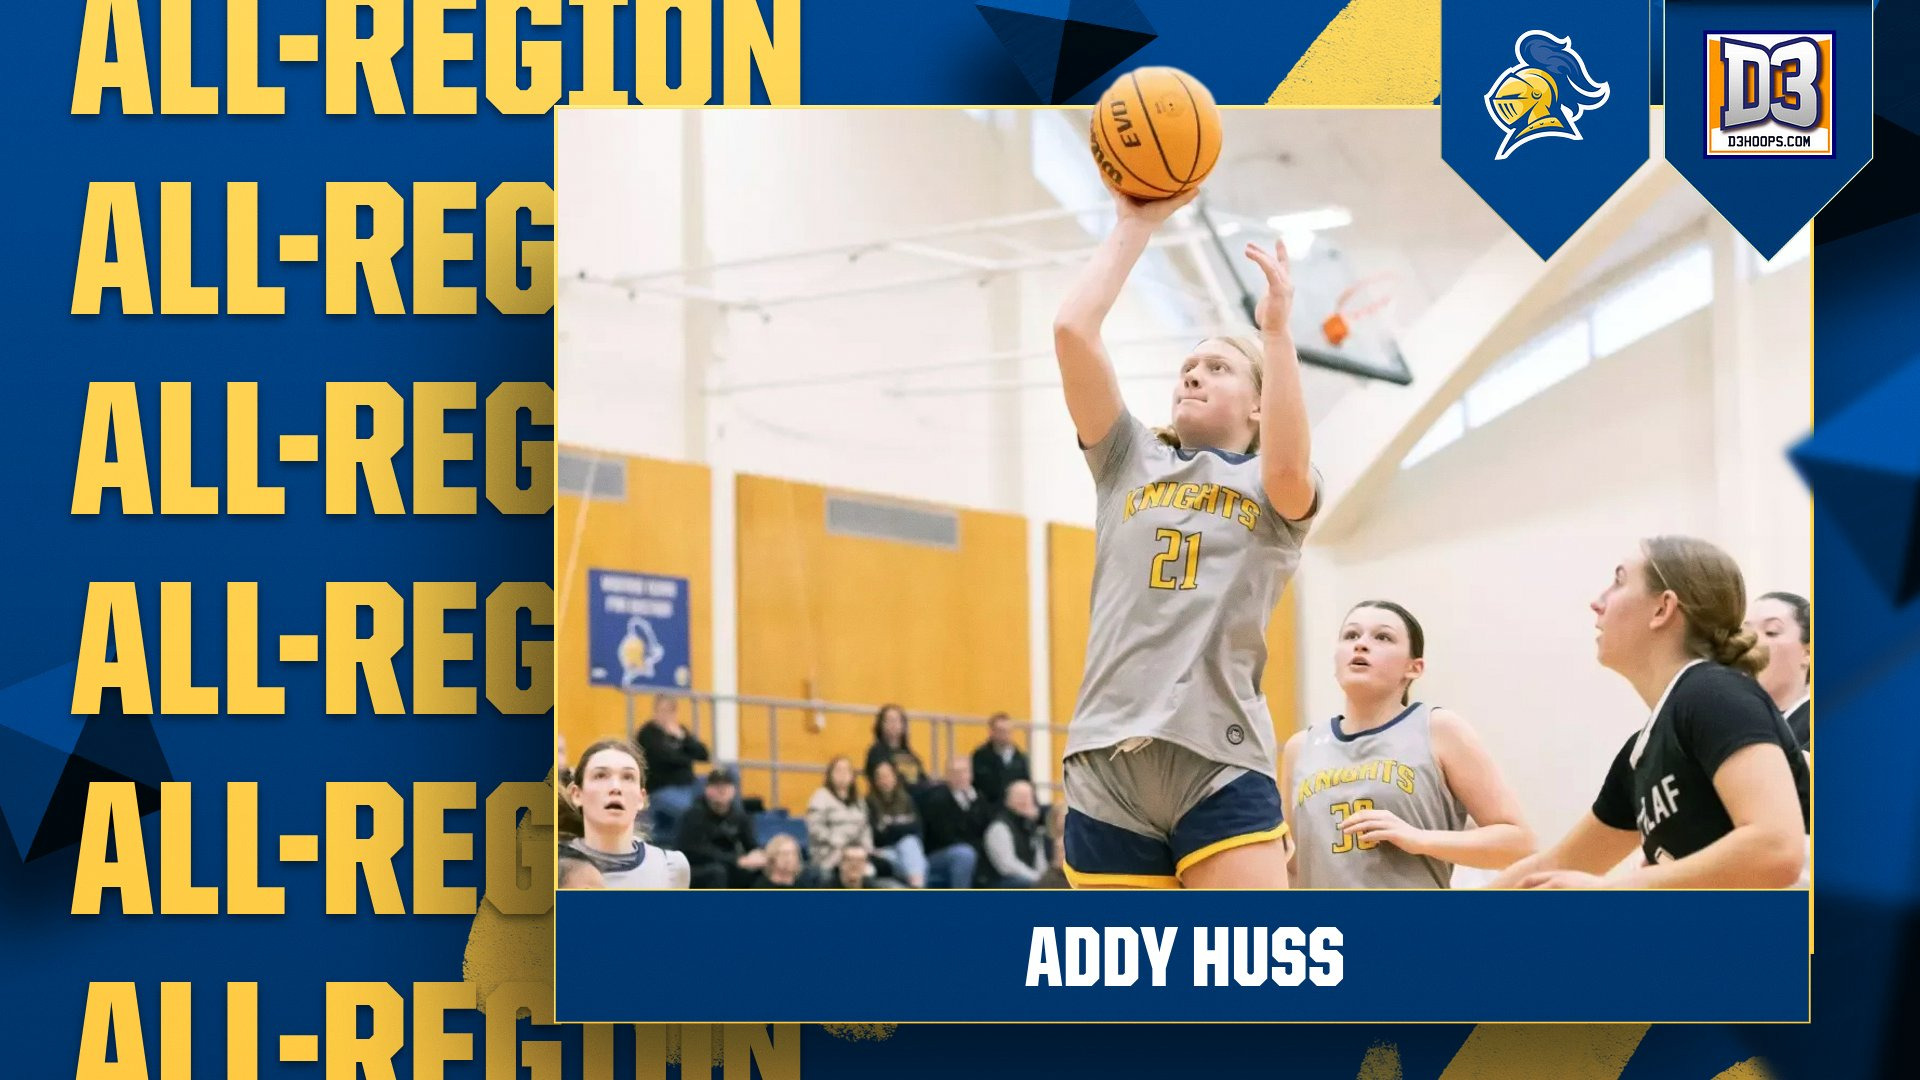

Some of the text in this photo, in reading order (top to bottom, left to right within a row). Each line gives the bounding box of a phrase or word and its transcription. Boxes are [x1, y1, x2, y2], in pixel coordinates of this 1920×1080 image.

[1122, 481, 1261, 532] KNIGHTS
[1149, 528, 1203, 590] 21
[1298, 759, 1416, 808] KNIGHTS
